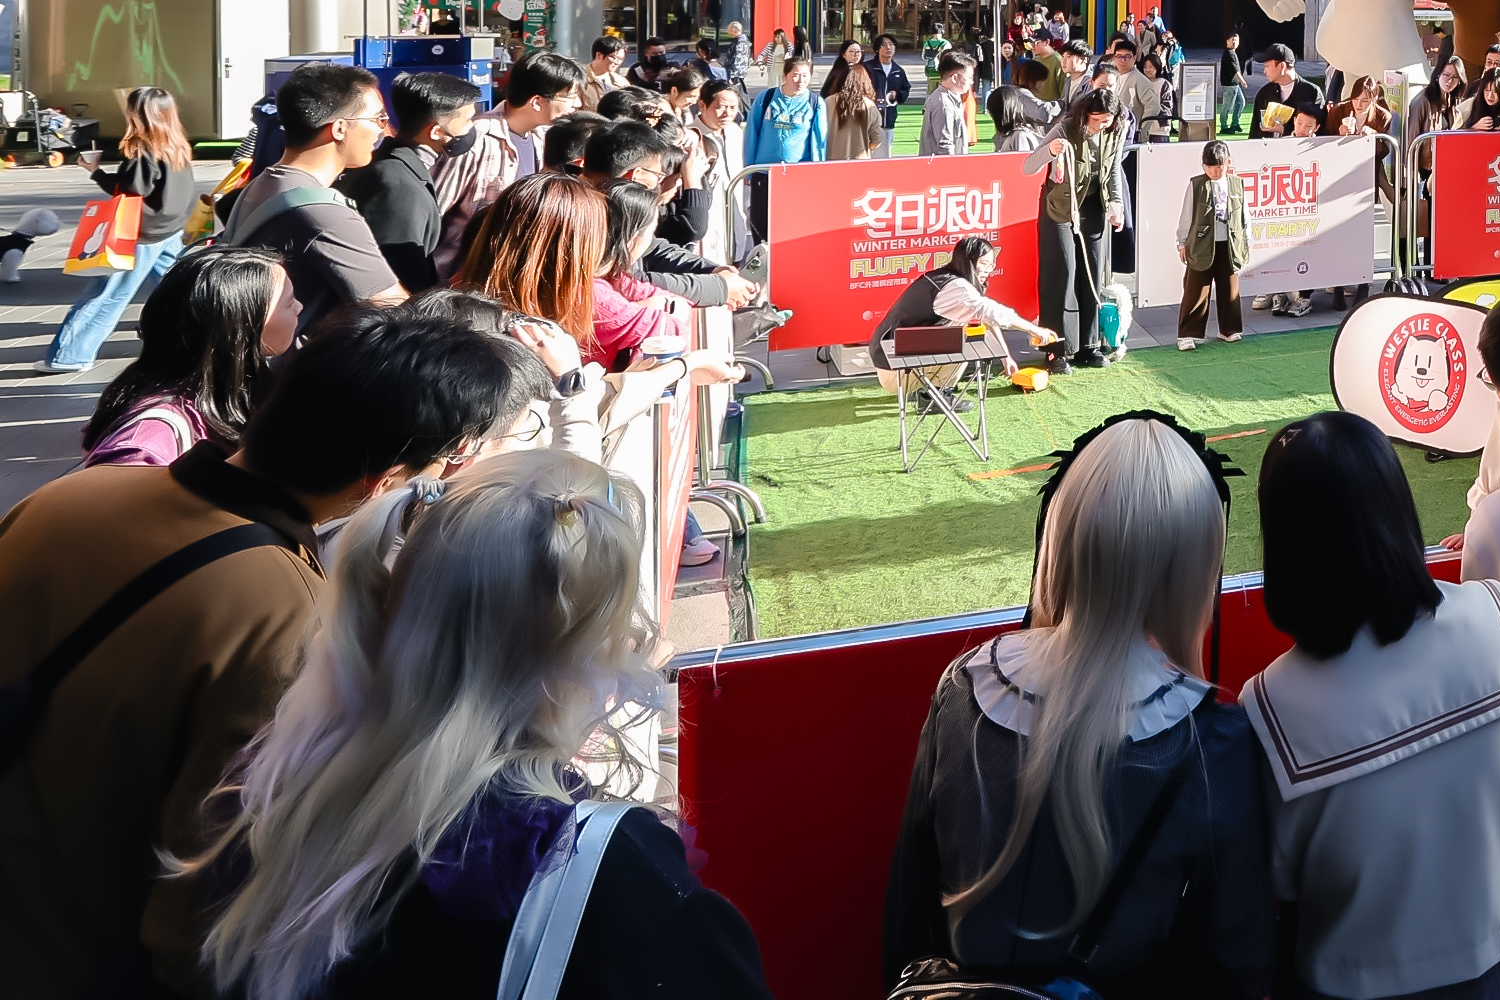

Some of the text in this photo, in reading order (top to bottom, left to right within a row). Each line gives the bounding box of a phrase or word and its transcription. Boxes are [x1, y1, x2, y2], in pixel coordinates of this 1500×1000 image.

[1228, 162, 1319, 208] 日派对
[853, 182, 1002, 239] 冬日派对
[1249, 205, 1317, 218] MARKET TIME
[853, 239, 907, 253] WINTER
[1267, 219, 1319, 239] PARTY
[851, 253, 931, 278] FLUFFY
[1384, 318, 1464, 373] WESTIE CLASS
[1383, 368, 1461, 426] ELEGANT ENERGETIC EVERLASTING
